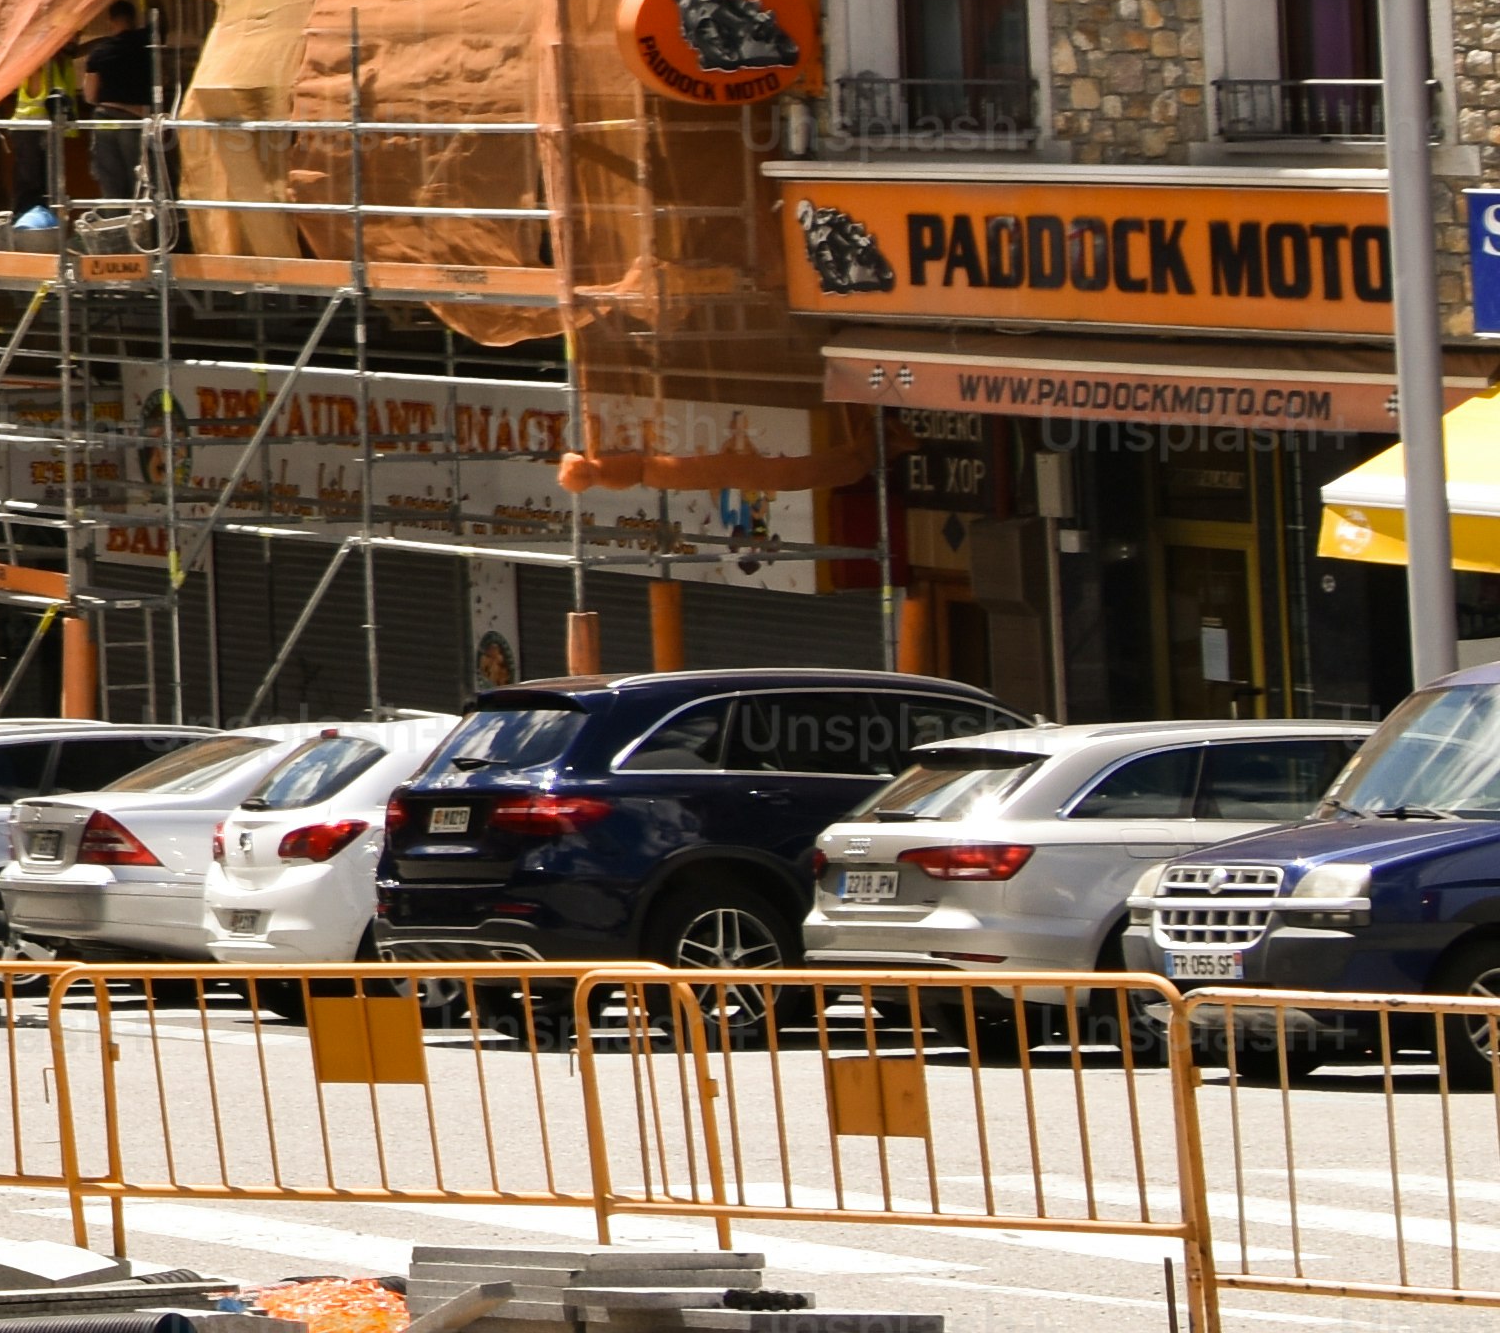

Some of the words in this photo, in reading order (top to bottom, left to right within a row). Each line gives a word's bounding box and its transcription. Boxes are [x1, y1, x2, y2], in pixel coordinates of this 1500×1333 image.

[639, 35, 716, 101] PADDOCK
[724, 72, 781, 101] MOTO
[908, 213, 1197, 295] PADDOCK
[1209, 221, 1393, 304] MOTO
[958, 375, 1332, 421] WWW.PADDOCKMOTO.COM
[909, 455, 935, 491] EL
[945, 456, 986, 495] XOP
